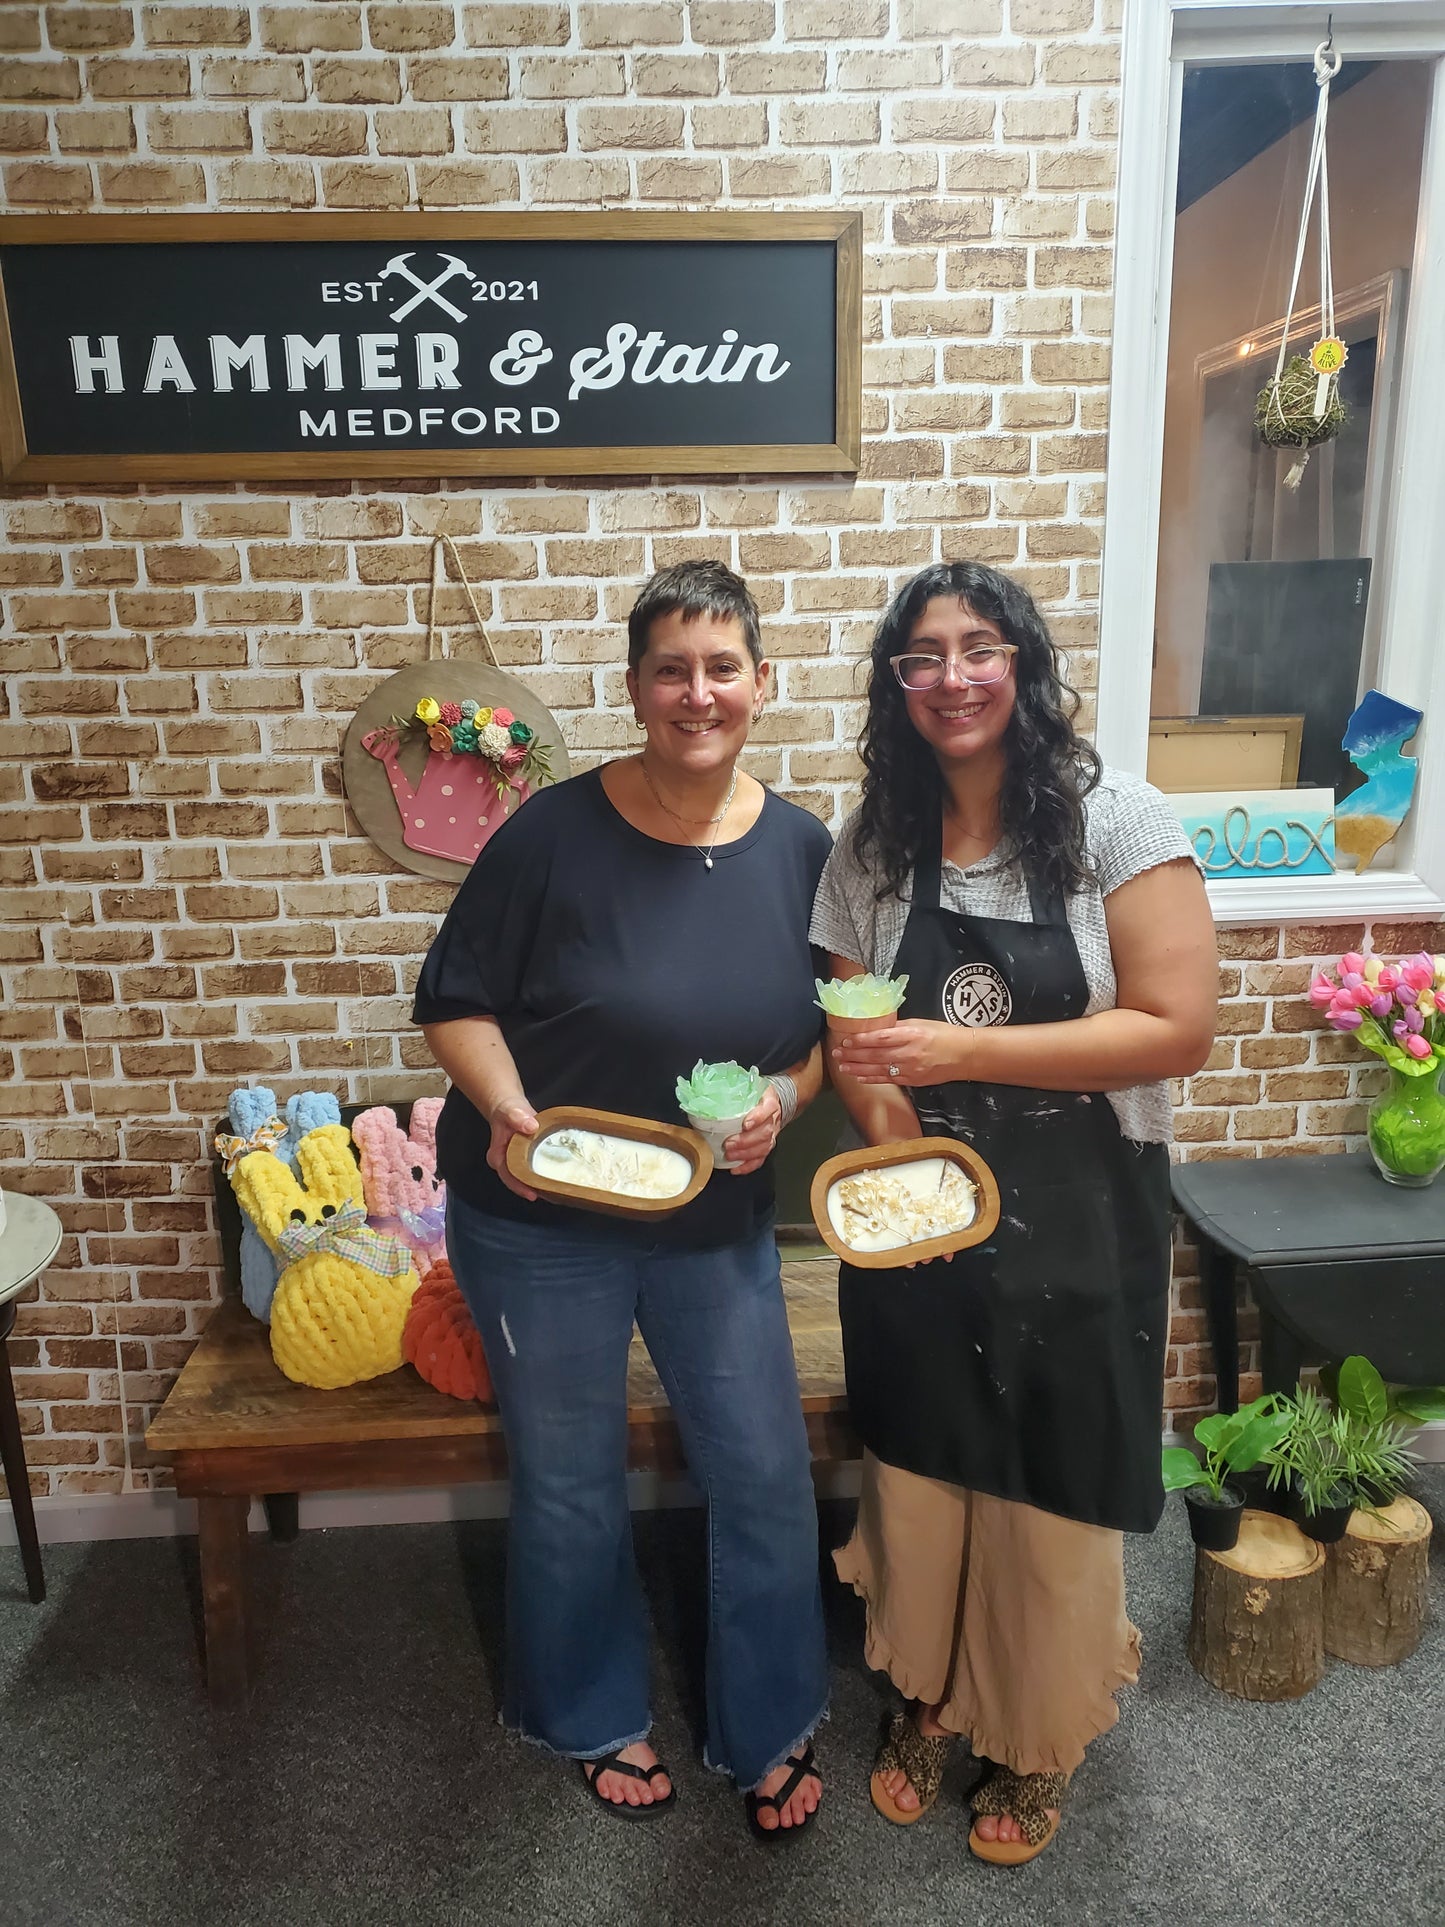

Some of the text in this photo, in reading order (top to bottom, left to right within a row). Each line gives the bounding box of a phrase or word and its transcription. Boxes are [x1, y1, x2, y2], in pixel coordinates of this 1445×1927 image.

[321, 280, 539, 303] EST. 2021
[68, 322, 791, 401] HAMMER & Stain
[1318, 358, 1338, 368] ALIVE
[300, 406, 561, 437] MEDFORD
[1192, 805, 1336, 872] elax
[950, 966, 984, 987] HAMMER
[993, 973, 1007, 998] STAIN
[959, 991, 998, 1013] H S
